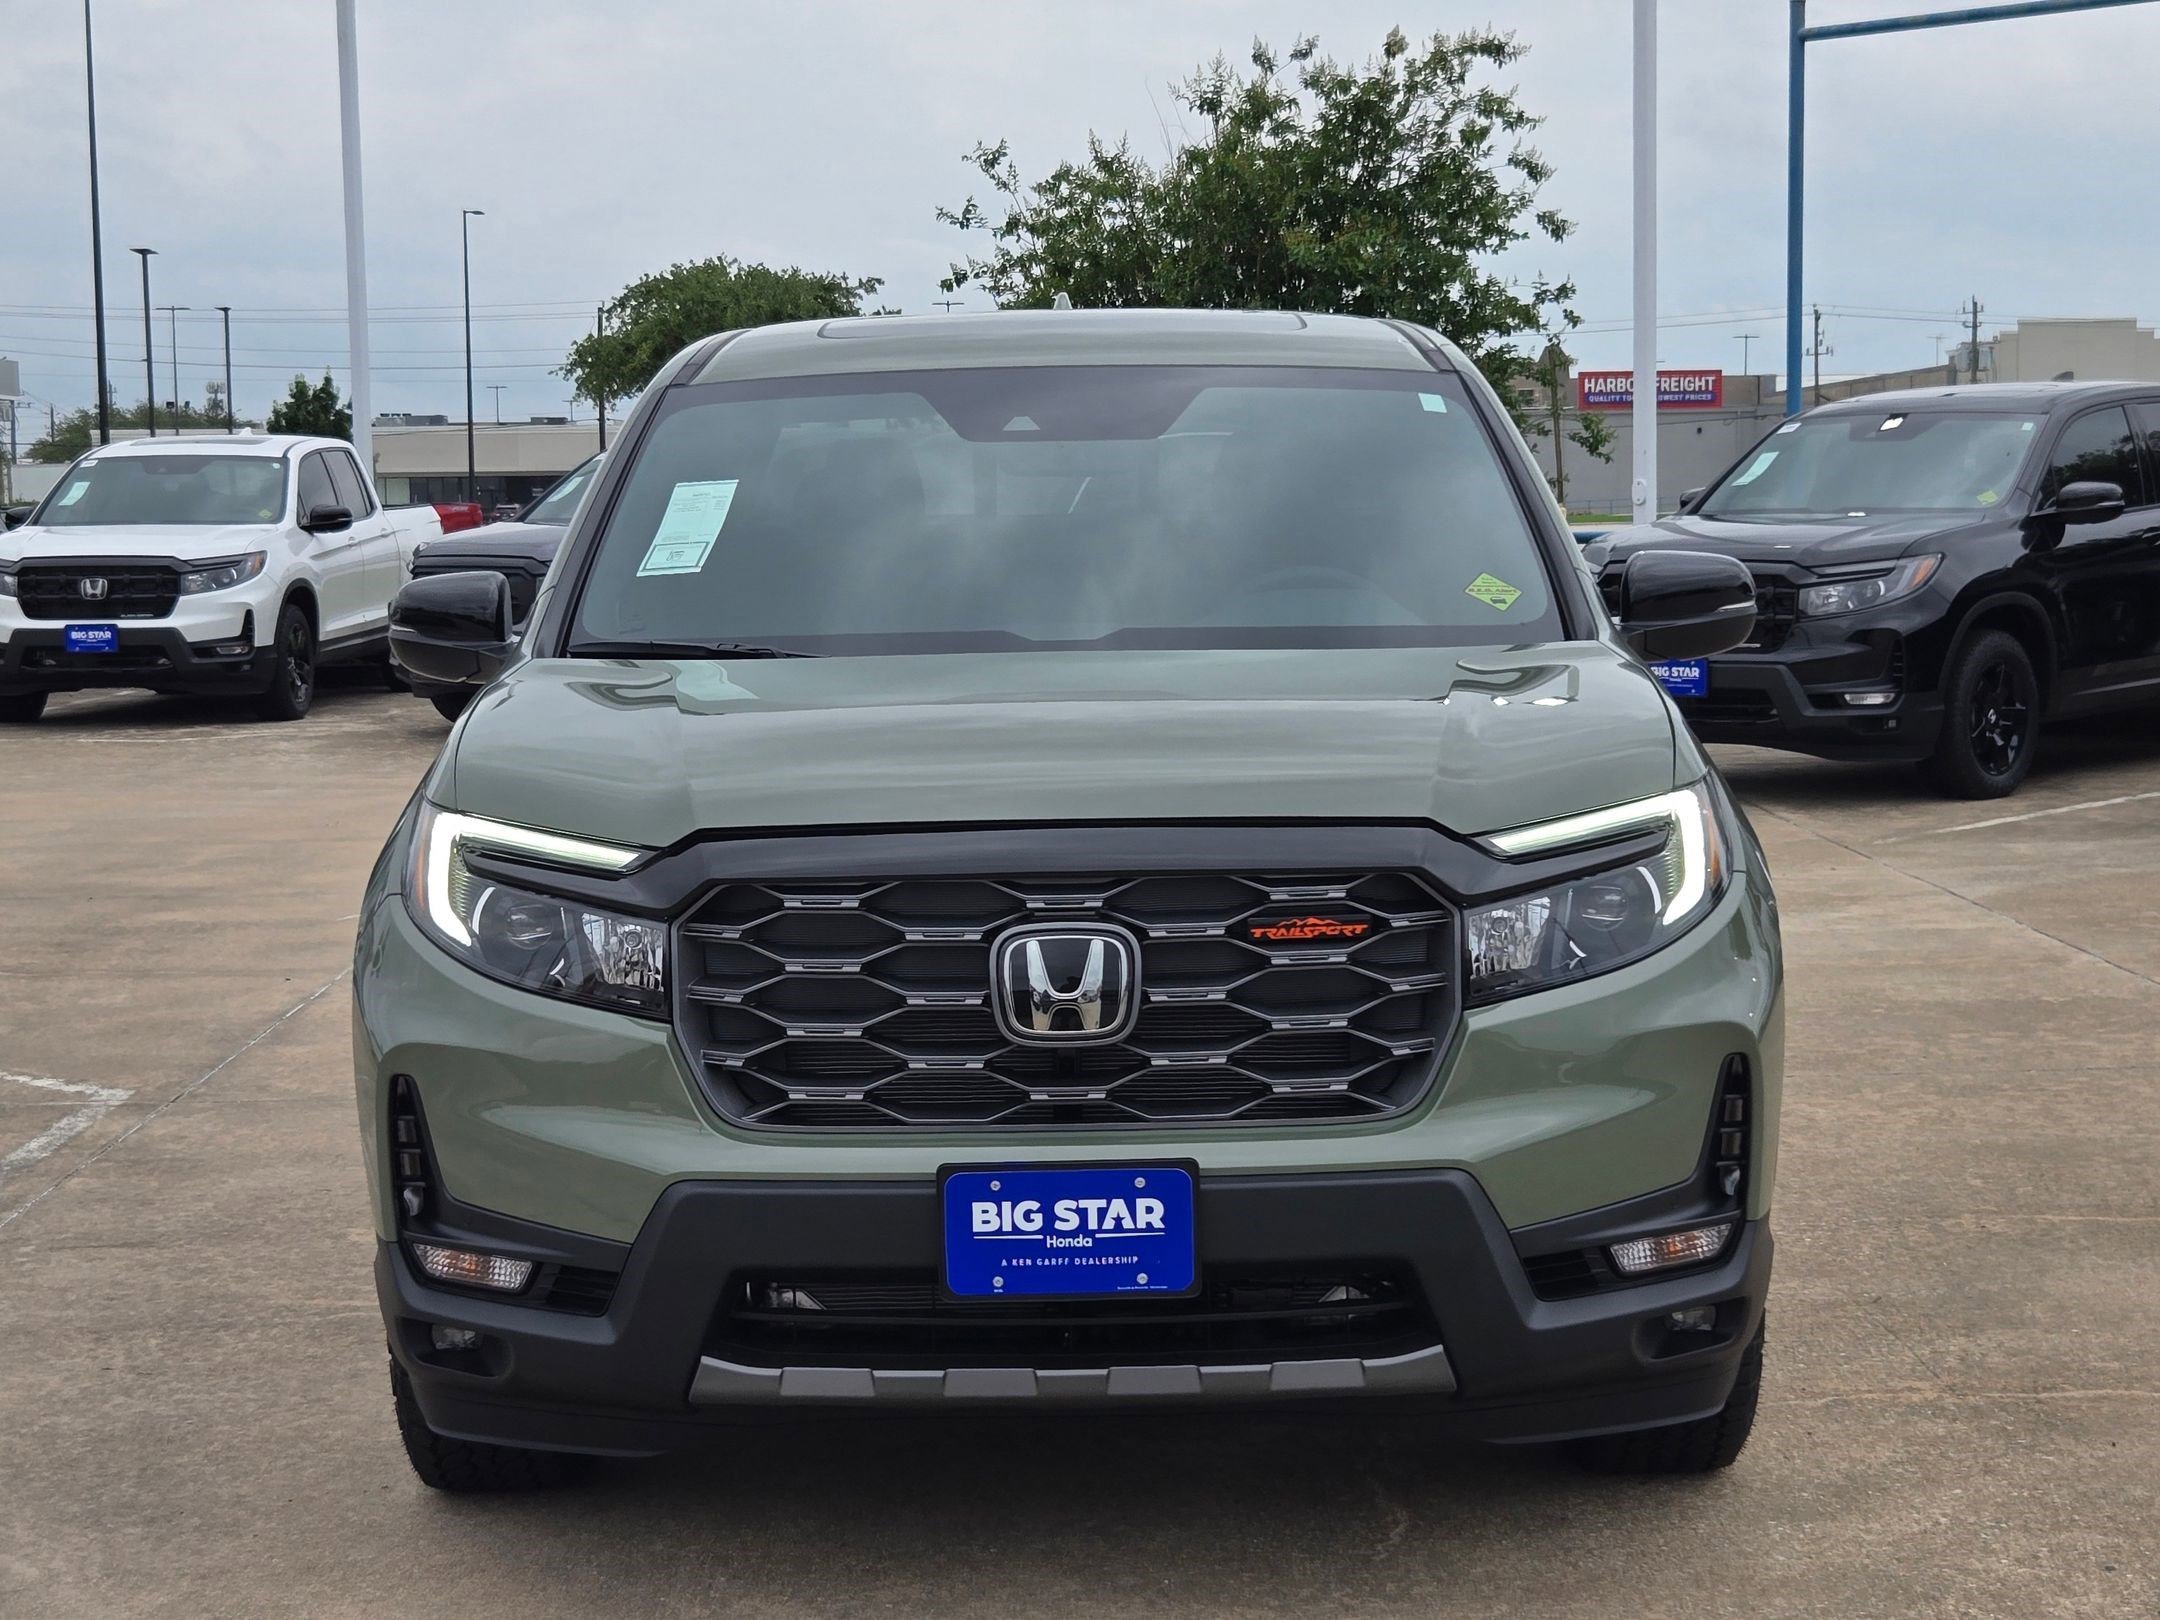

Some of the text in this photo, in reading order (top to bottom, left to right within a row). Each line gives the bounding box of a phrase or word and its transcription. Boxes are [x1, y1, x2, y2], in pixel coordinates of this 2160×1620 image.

[1585, 377, 1633, 393] HARBO
[1685, 393, 1712, 401] PRICES
[71, 631, 112, 639] BIG STAR
[1671, 666, 1700, 678] STAR
[1250, 924, 1369, 940] TRAILSPORT
[972, 1198, 1166, 1233] BIG STAR
[1046, 1234, 1093, 1248] Honda
[1001, 1256, 1139, 1267] A KEN GARFF DEALERSHIP
